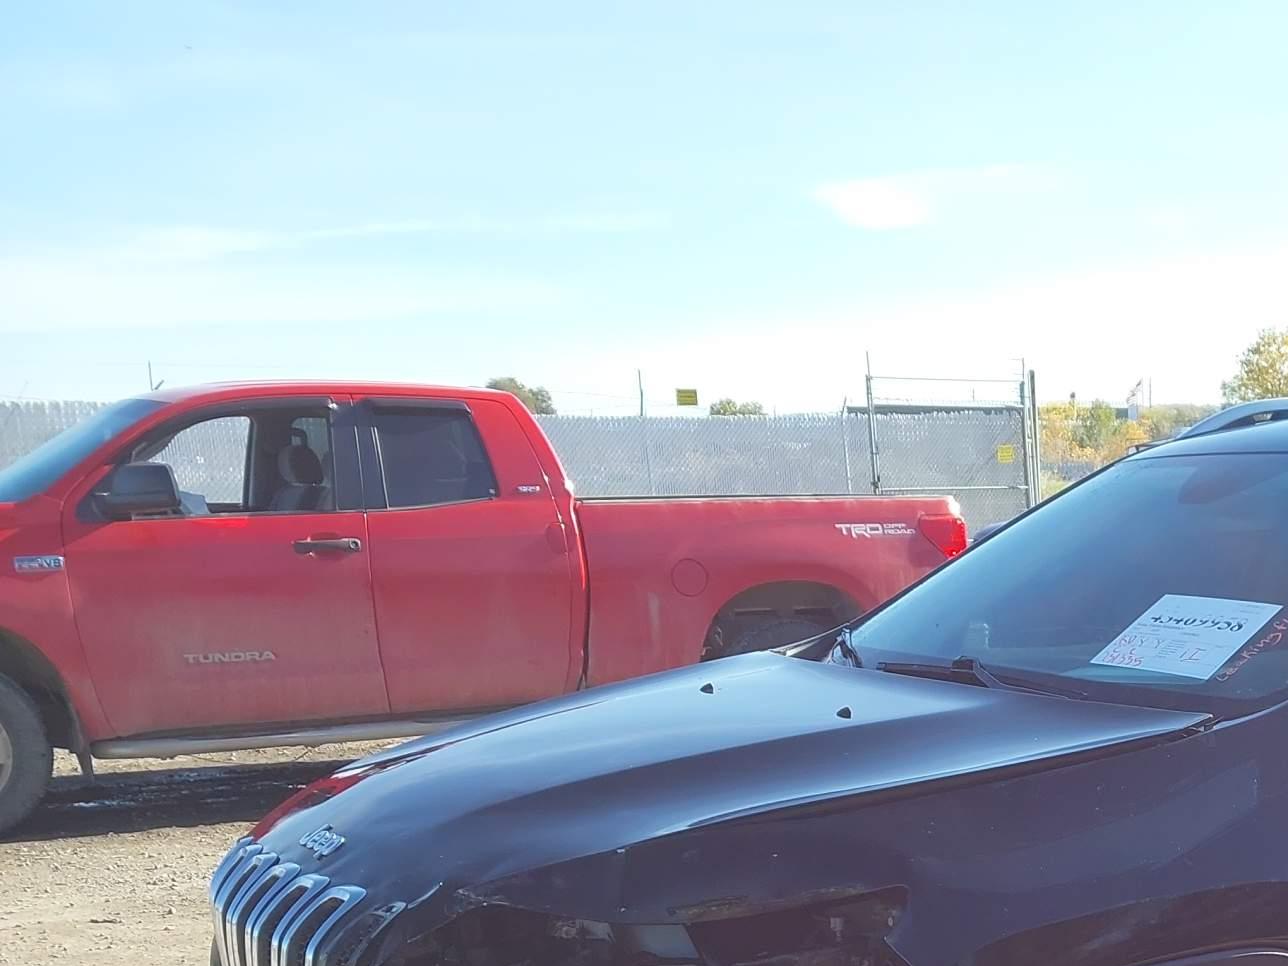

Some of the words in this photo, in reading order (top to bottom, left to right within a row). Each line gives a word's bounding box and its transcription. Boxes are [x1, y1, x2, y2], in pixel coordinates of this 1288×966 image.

[834, 523, 883, 539] TRD
[183, 651, 277, 664] TUNDRA
[299, 823, 346, 858] Jeep
